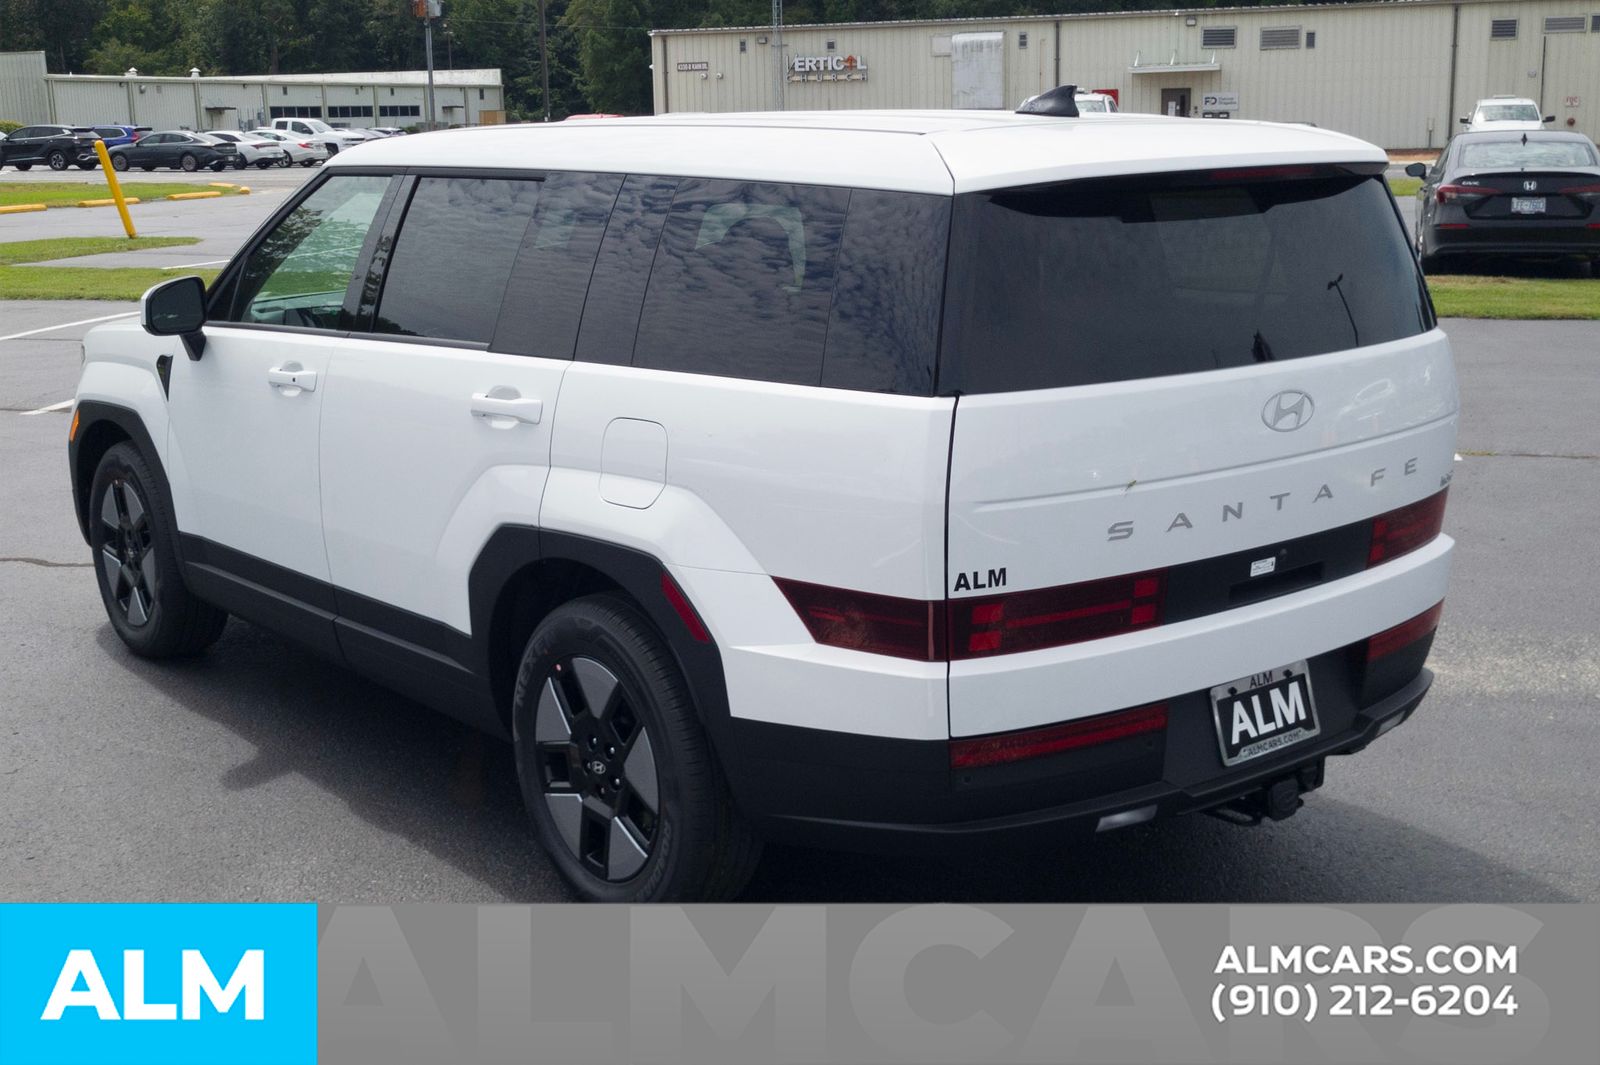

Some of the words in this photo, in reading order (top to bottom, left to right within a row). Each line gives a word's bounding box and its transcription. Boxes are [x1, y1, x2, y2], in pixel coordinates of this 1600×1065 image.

[786, 72, 868, 83] CHURCH
[1107, 484, 1333, 541] SANTA
[1370, 457, 1418, 487] FE
[954, 568, 1007, 592] ALM
[1249, 670, 1274, 689] ALM
[1231, 681, 1307, 745] ALM
